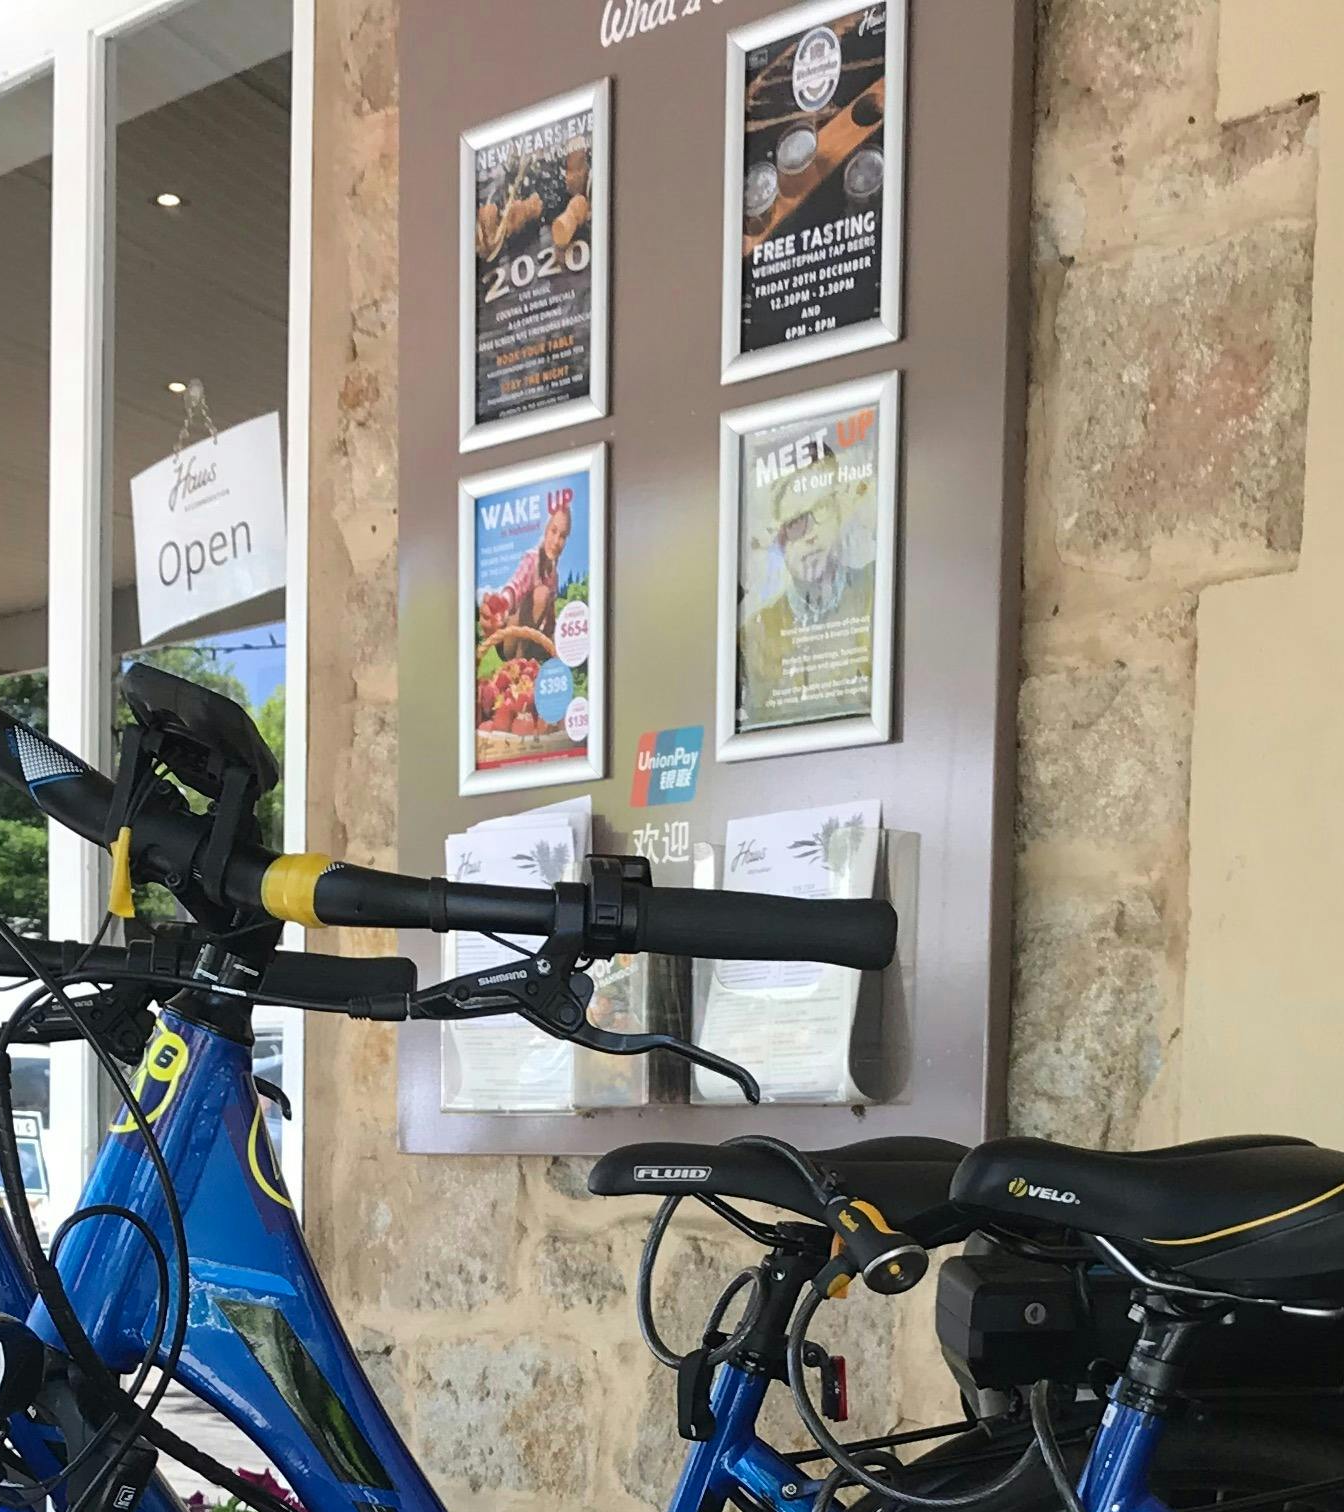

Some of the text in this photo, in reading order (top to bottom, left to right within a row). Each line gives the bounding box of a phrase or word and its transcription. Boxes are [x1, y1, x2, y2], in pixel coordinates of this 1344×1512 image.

[600, 0, 700, 48] Whas
[478, 143, 511, 170] NEW
[514, 124, 565, 157] YEARS
[753, 211, 875, 265] FREE TASTING
[828, 244, 845, 258] TAP
[847, 235, 875, 253] BEERS
[482, 239, 590, 303] 2020
[755, 256, 871, 299] FRIDAY 20TH DECEMBER
[770, 289, 810, 312] 12.30PM
[818, 277, 855, 298] 3.30PM
[801, 304, 821, 319] AND
[785, 324, 806, 340] 6PM
[815, 316, 836, 332] 8PM
[548, 335, 575, 352] TABLE
[756, 407, 874, 488] MEET UP
[168, 456, 217, 512] Haus
[793, 463, 873, 493] at our Haus
[480, 487, 573, 531] WAKE UP
[159, 520, 252, 591] Open
[561, 620, 588, 638] $654
[539, 676, 568, 696] $398
[568, 714, 588, 728] $139
[638, 747, 699, 771] UnionPay
[659, 769, 692, 790] 银联
[632, 821, 690, 864] 欢迎
[478, 969, 528, 986] SHIMANO
[153, 1044, 179, 1069] 6
[637, 1168, 707, 1179] FLUID
[1028, 1184, 1076, 1204] VELO
